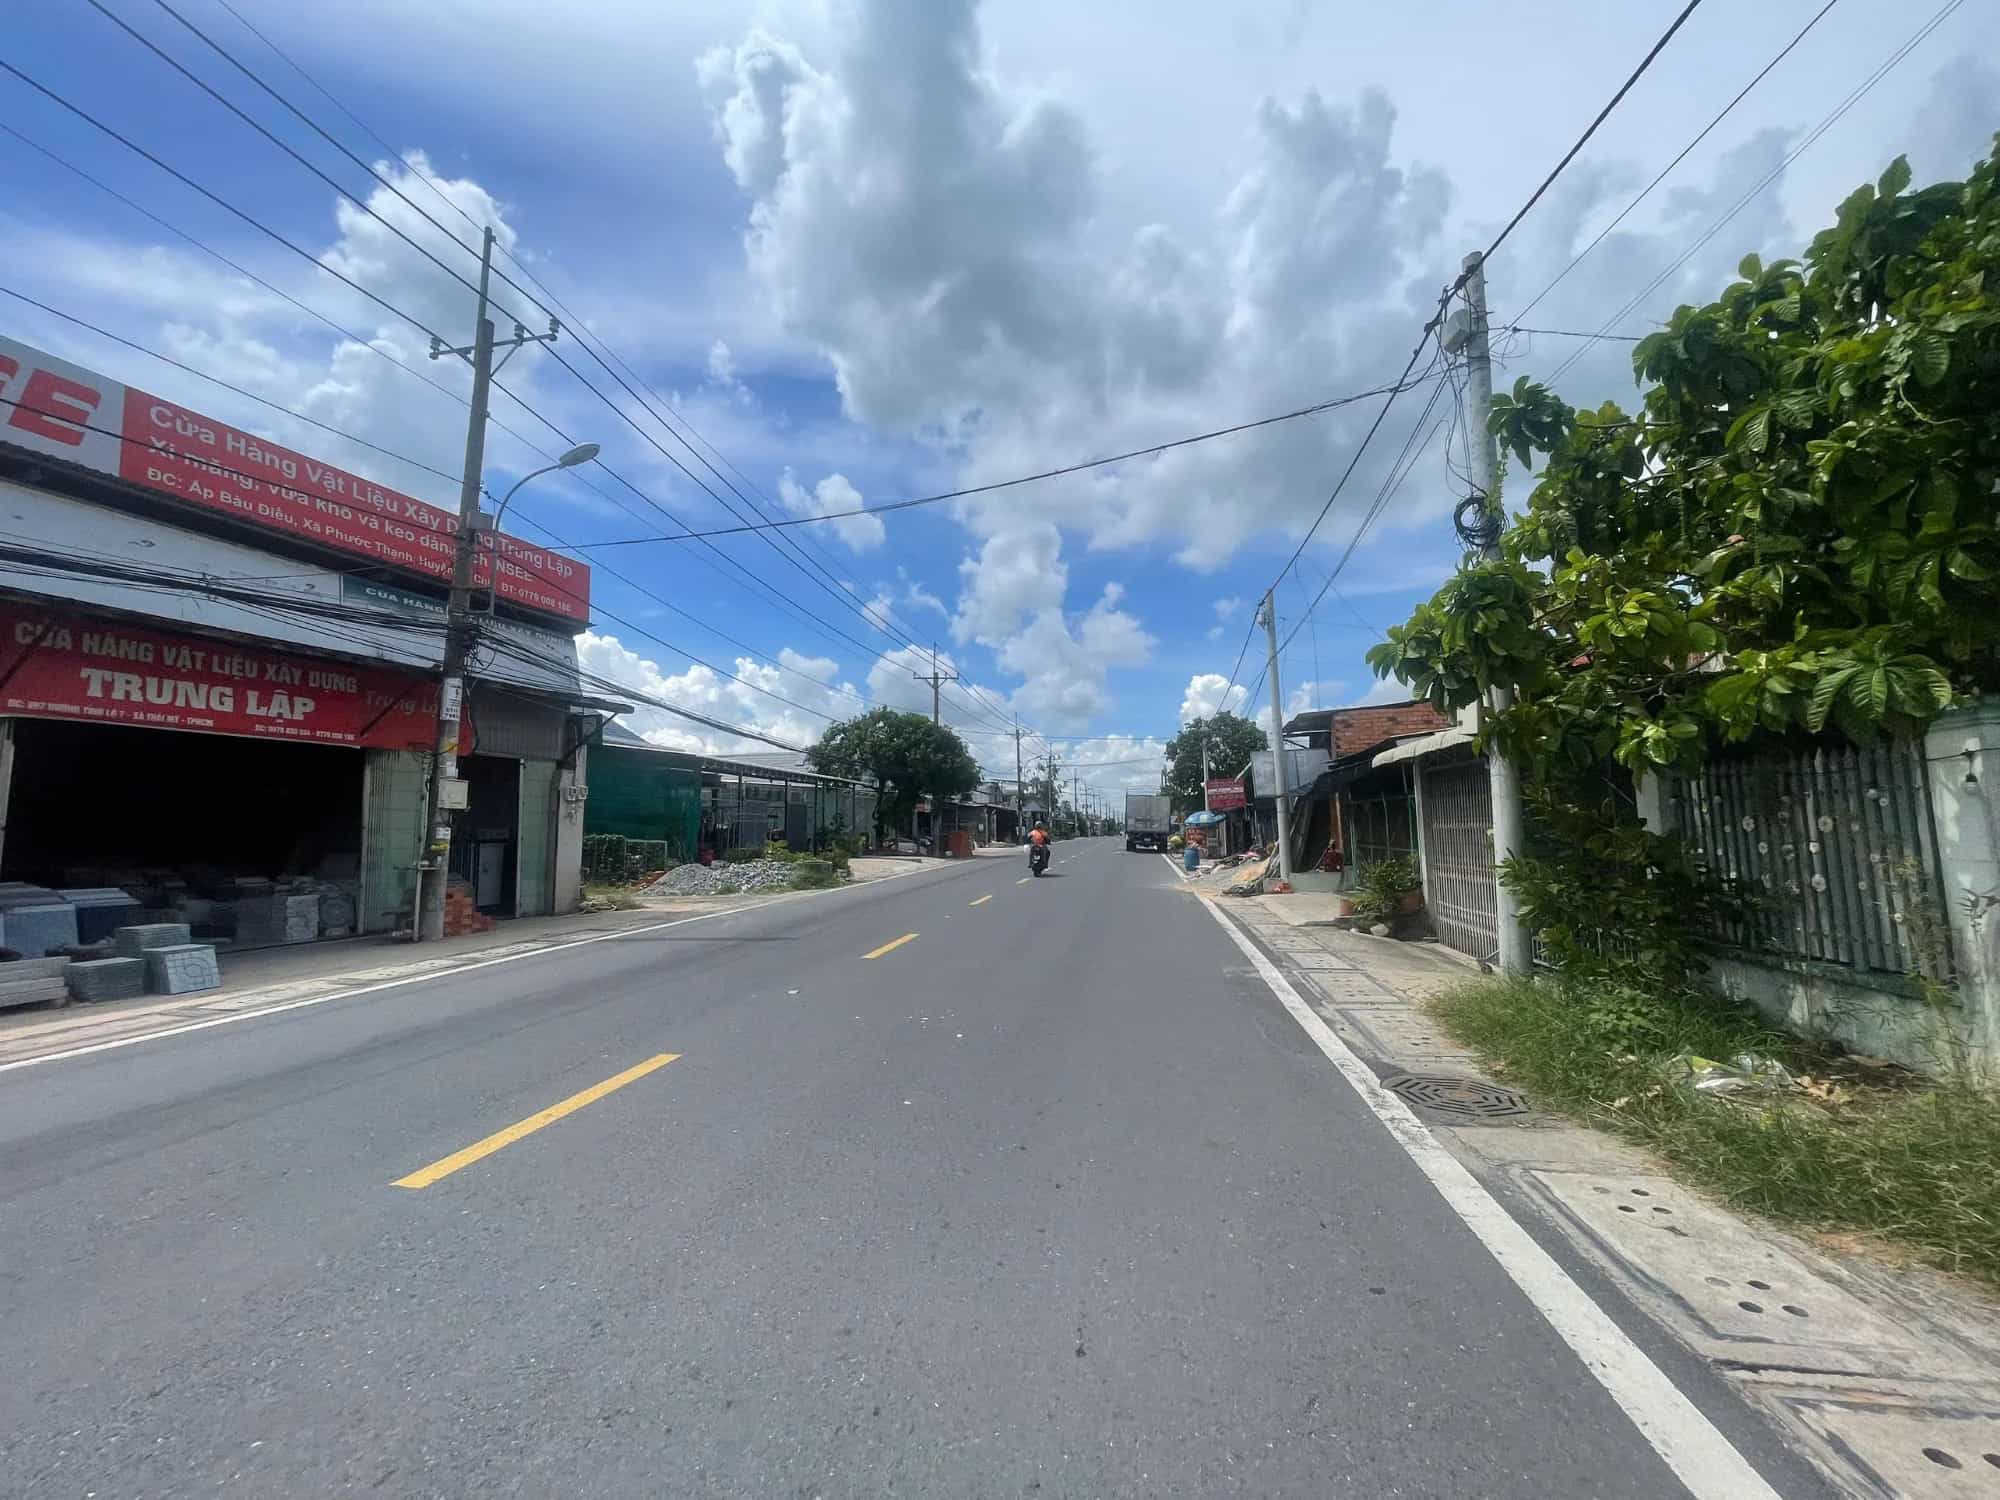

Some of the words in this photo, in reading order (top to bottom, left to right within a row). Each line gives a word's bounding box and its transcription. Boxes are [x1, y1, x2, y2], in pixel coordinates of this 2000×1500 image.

[226, 431, 297, 480] Hàng
[305, 463, 345, 494] Vật
[352, 481, 398, 512] Liệu
[404, 501, 441, 531] Xây
[446, 518, 494, 550] Dng
[358, 512, 380, 531] và
[384, 520, 416, 542] keo
[491, 558, 536, 582] NSEE
[81, 631, 154, 664] HÀNG
[163, 645, 206, 673] VẬT
[212, 654, 258, 681] LIỆU
[264, 658, 305, 685] XÂY
[80, 668, 234, 713] TRUNG
[246, 689, 316, 724] LẬP
